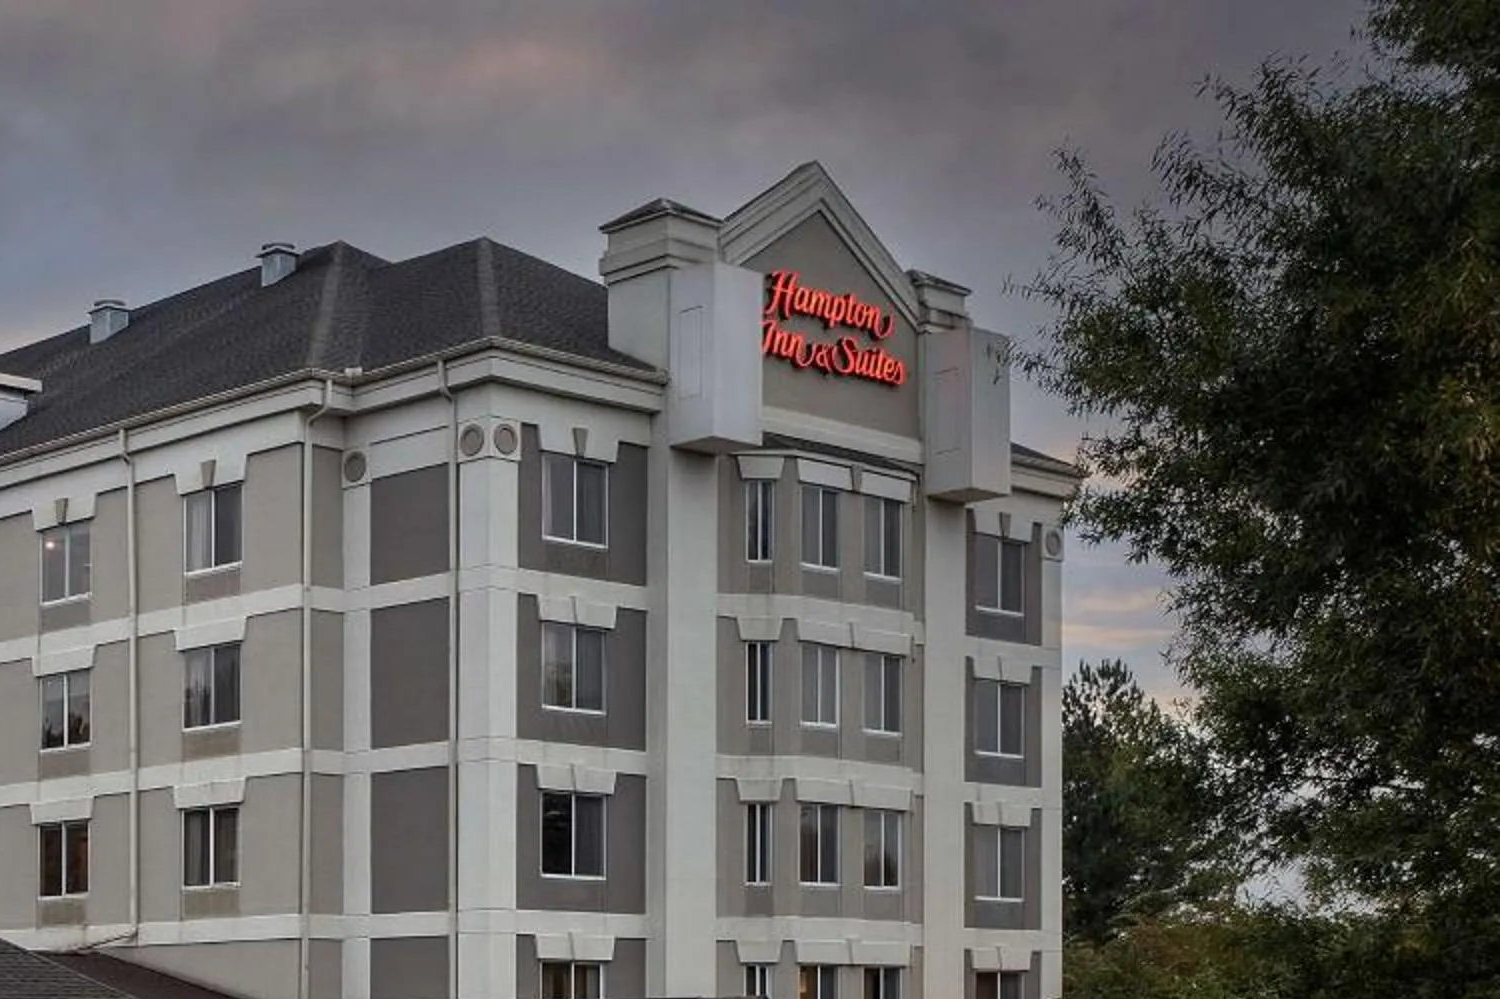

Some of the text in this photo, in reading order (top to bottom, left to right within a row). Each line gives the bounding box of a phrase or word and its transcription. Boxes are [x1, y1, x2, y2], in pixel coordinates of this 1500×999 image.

[764, 271, 894, 338] Hampton
[760, 320, 904, 384] Inn & Suites
